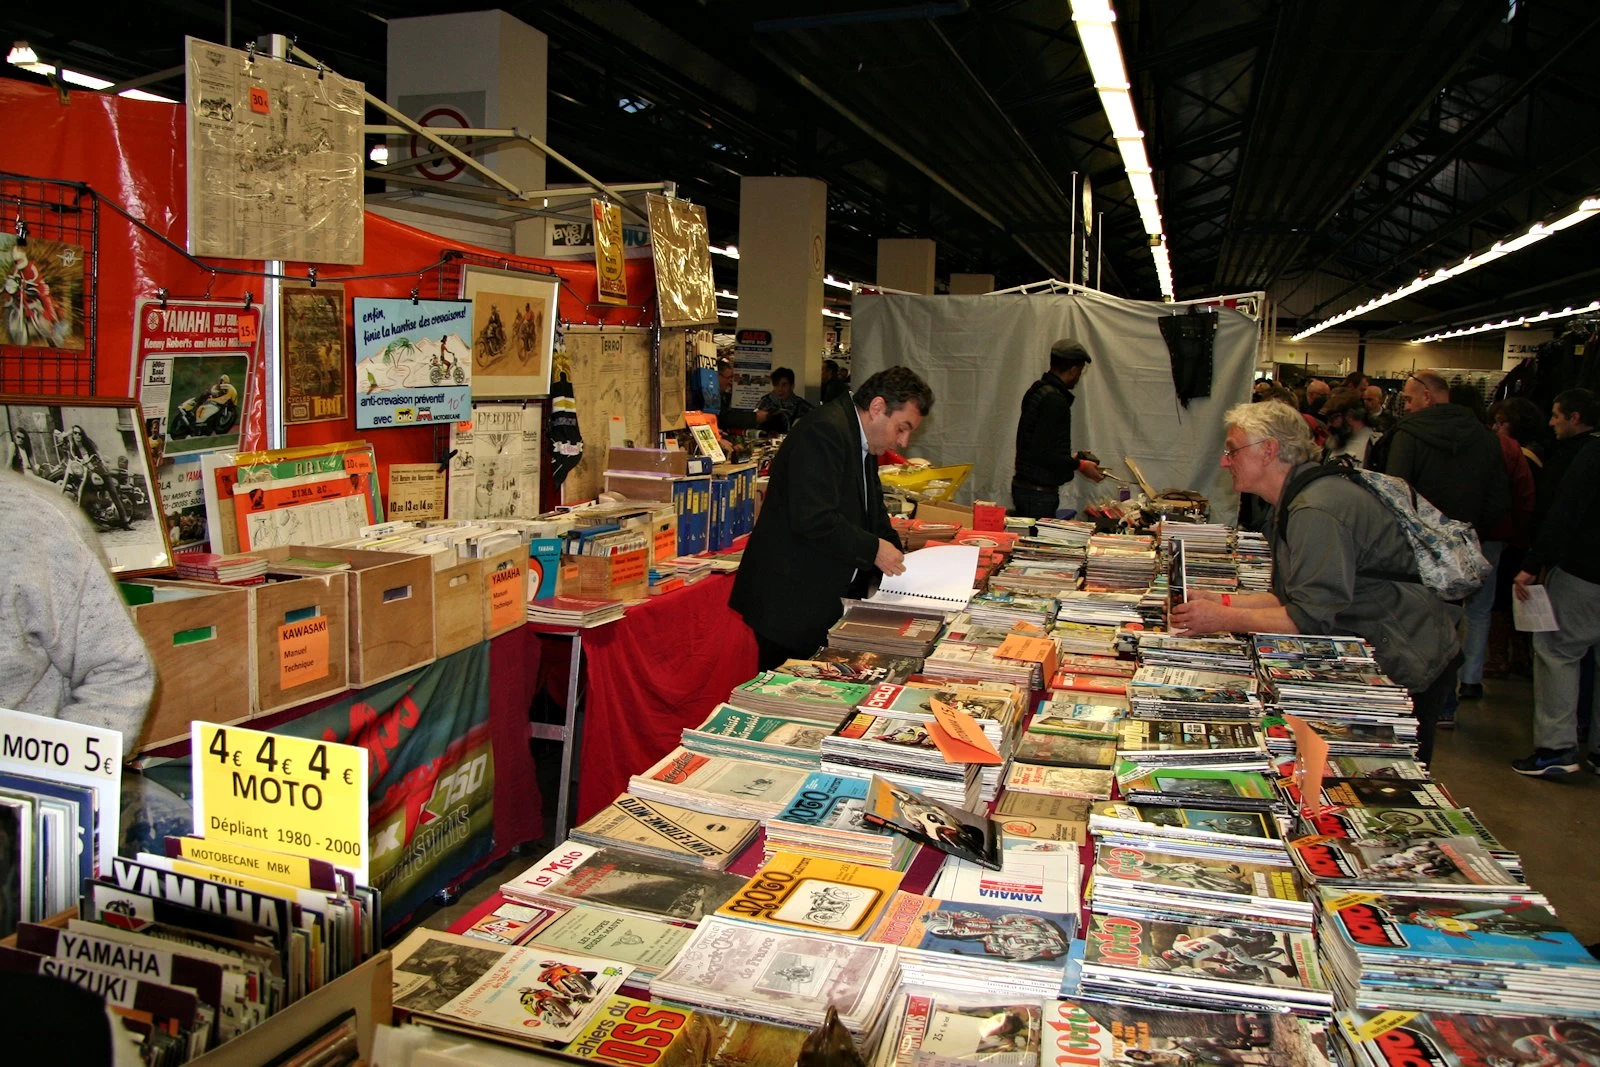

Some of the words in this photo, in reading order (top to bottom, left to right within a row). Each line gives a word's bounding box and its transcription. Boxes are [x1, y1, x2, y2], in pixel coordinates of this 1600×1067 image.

[162, 310, 211, 333] YAMAHA
[418, 315, 431, 329] des
[166, 337, 193, 349] Roberts
[360, 394, 413, 407] anti-crevaison
[414, 393, 446, 406] préventif
[373, 415, 393, 425] avec
[491, 567, 521, 585] YAMAHA
[283, 620, 327, 641] KAWASAKI
[283, 646, 308, 659] Manuel
[283, 658, 315, 674] Technique
[869, 686, 896, 708] CYCLO
[3, 733, 70, 766] MOTO
[232, 771, 323, 811] MOTO
[439, 753, 488, 812] 750
[210, 815, 269, 840] Dépliant
[277, 828, 312, 848] 1980
[325, 837, 361, 857] 2000
[190, 848, 260, 869] MOTOBECANE
[267, 861, 291, 875] MBK
[525, 876, 553, 889] La
[548, 850, 583, 878] Moto
[727, 870, 795, 917] MOTO
[979, 887, 1043, 903] YAMAHA
[62, 934, 161, 978] YAMAHA
[576, 1019, 616, 1057] ahiers
[607, 1000, 631, 1017] du
[1069, 1006, 1092, 1049] verte
